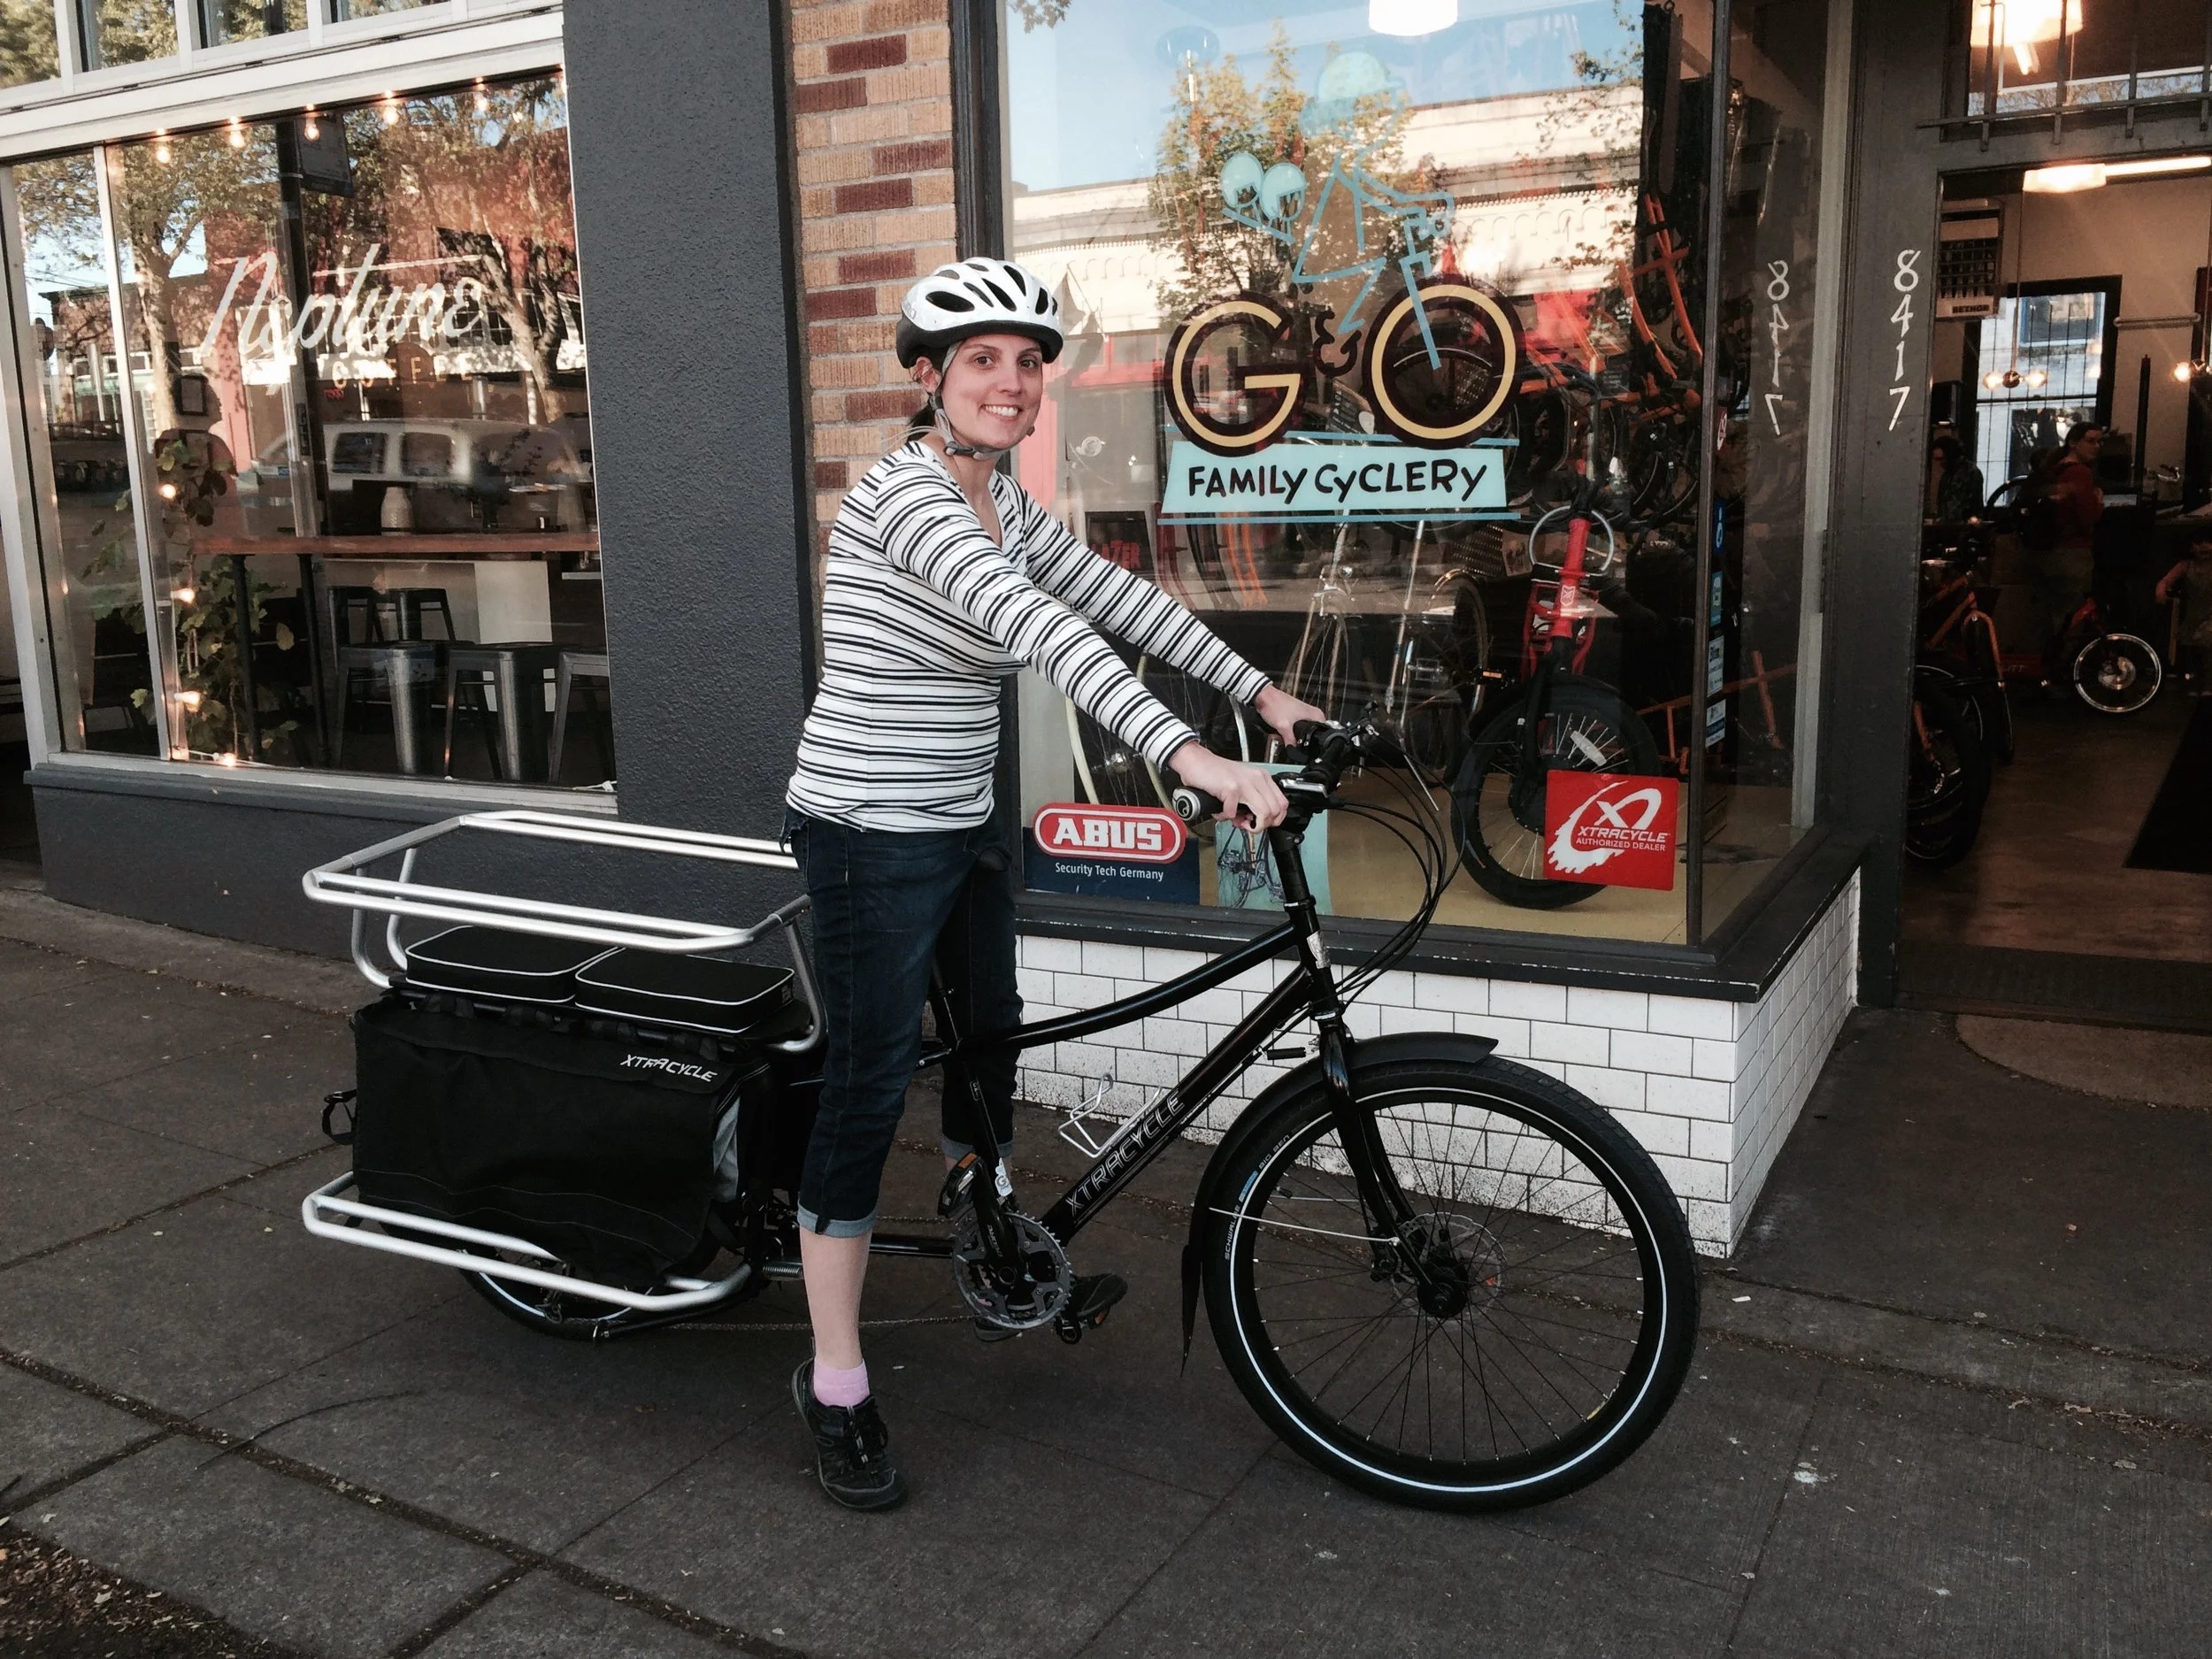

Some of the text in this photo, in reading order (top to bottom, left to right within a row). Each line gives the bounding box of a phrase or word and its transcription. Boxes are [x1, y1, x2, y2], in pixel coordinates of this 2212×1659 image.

[200, 243, 485, 395] Neptune
[1889, 249, 1921, 433] 8417
[1188, 458, 1488, 504] FAMILY CYCLERY
[1053, 818, 1162, 850] ABUS
[1576, 837, 1666, 851] AUTHORIZED DEALER
[1578, 826, 1667, 843] XTRACYCLE
[1055, 862, 1164, 882] Security Tech Germany
[620, 1054, 718, 1082] XTRACYCLE
[1065, 1087, 1186, 1217] XTRACYCLE
